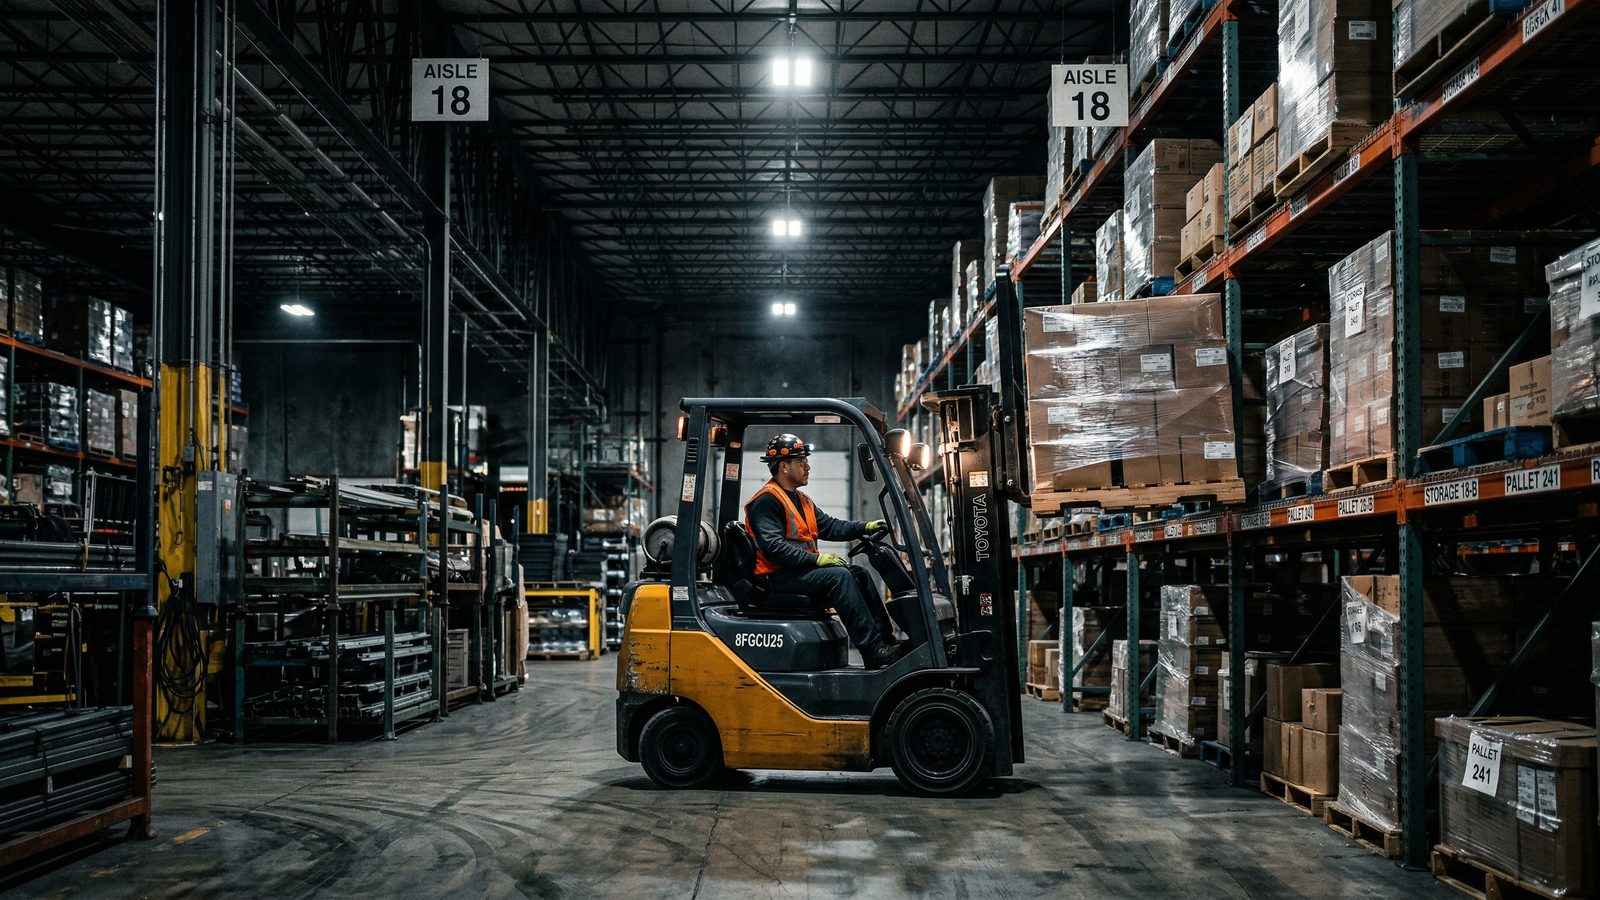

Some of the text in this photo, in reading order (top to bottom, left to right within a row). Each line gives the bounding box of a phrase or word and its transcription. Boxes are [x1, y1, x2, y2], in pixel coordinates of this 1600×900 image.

[423, 64, 478, 79] AISLE
[1063, 69, 1117, 85] AISLE
[431, 85, 471, 116] 18
[1071, 91, 1110, 121] 18
[1506, 468, 1558, 493] PALLET 241
[1425, 481, 1478, 504] STORAGE 18-B
[1339, 500, 1358, 515] PALLET
[972, 493, 990, 563] TOYOTA
[735, 633, 784, 648] 8FGCU25
[1471, 743, 1498, 761] PALLET
[1472, 764, 1491, 785] 241
